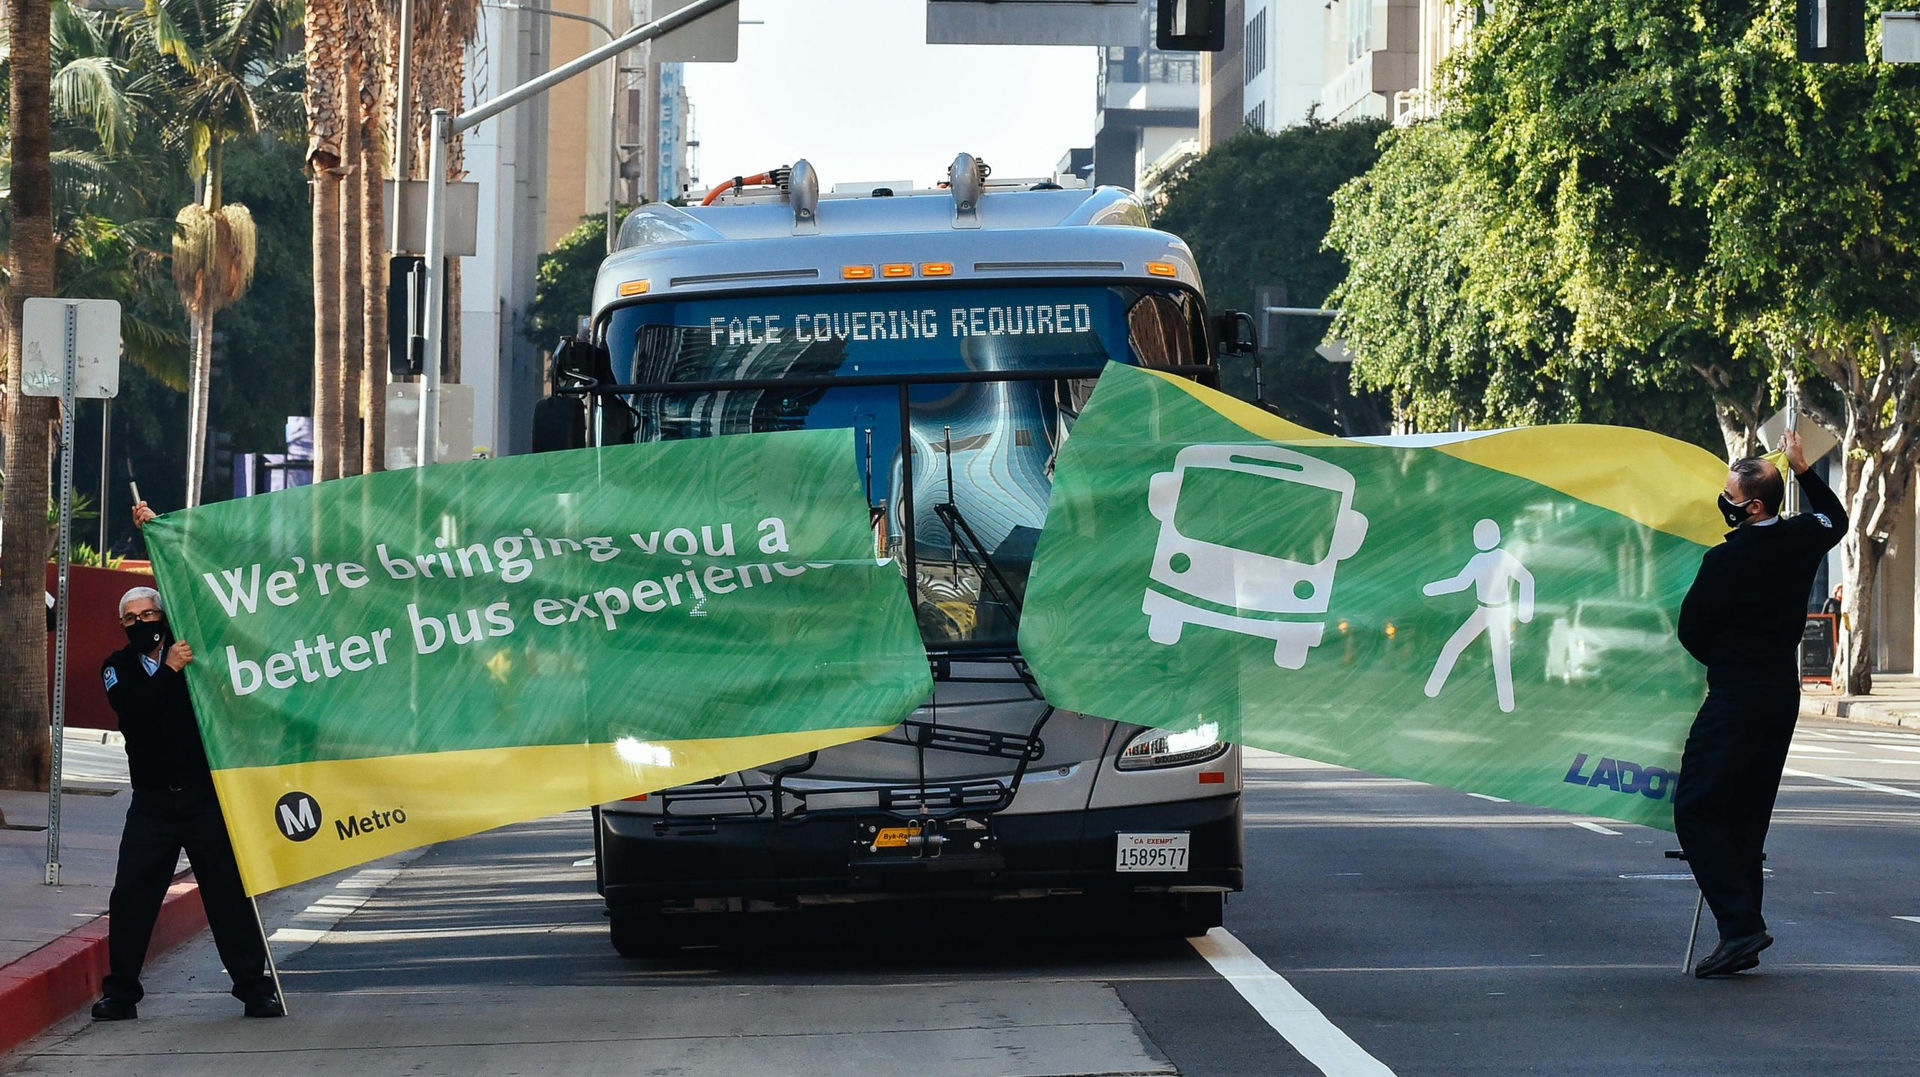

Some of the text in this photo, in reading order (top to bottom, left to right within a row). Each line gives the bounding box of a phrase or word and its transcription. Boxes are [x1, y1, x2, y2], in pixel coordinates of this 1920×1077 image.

[710, 303, 1091, 345] FACE COVERING REQUIRED
[203, 517, 790, 617] We're bringing you a
[225, 558, 834, 697] better bus experienc
[279, 797, 317, 836] M
[335, 807, 407, 841] Metro
[883, 832, 910, 841] Byk-Ra
[1119, 848, 1187, 866] 1589577
